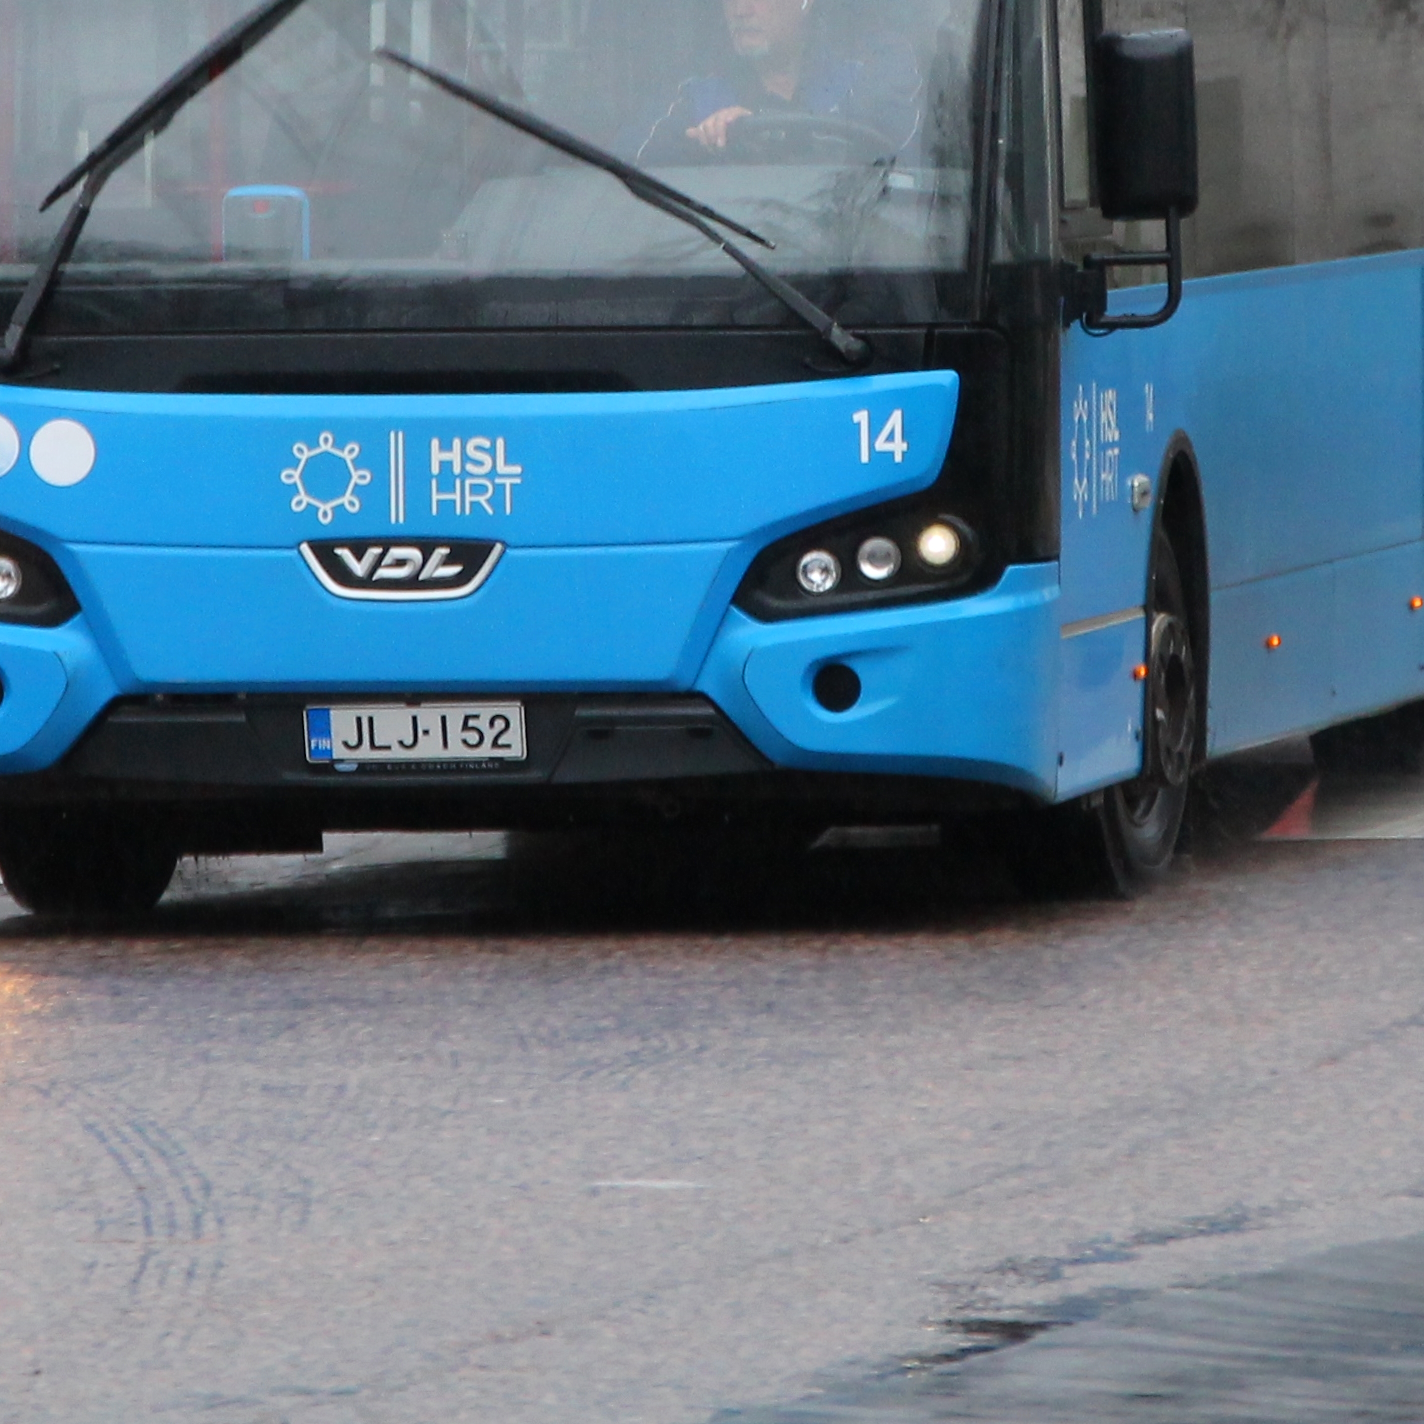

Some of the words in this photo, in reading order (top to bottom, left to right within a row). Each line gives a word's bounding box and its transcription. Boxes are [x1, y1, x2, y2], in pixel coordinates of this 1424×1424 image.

[1100, 389, 1120, 442] HSL
[430, 436, 523, 476] HSL
[851, 408, 908, 464] 14
[1100, 448, 1120, 501] HRT
[430, 476, 523, 516] HRT
[333, 546, 464, 582] VDL
[310, 739, 331, 751] FIN
[341, 713, 512, 751] JLJ-152
